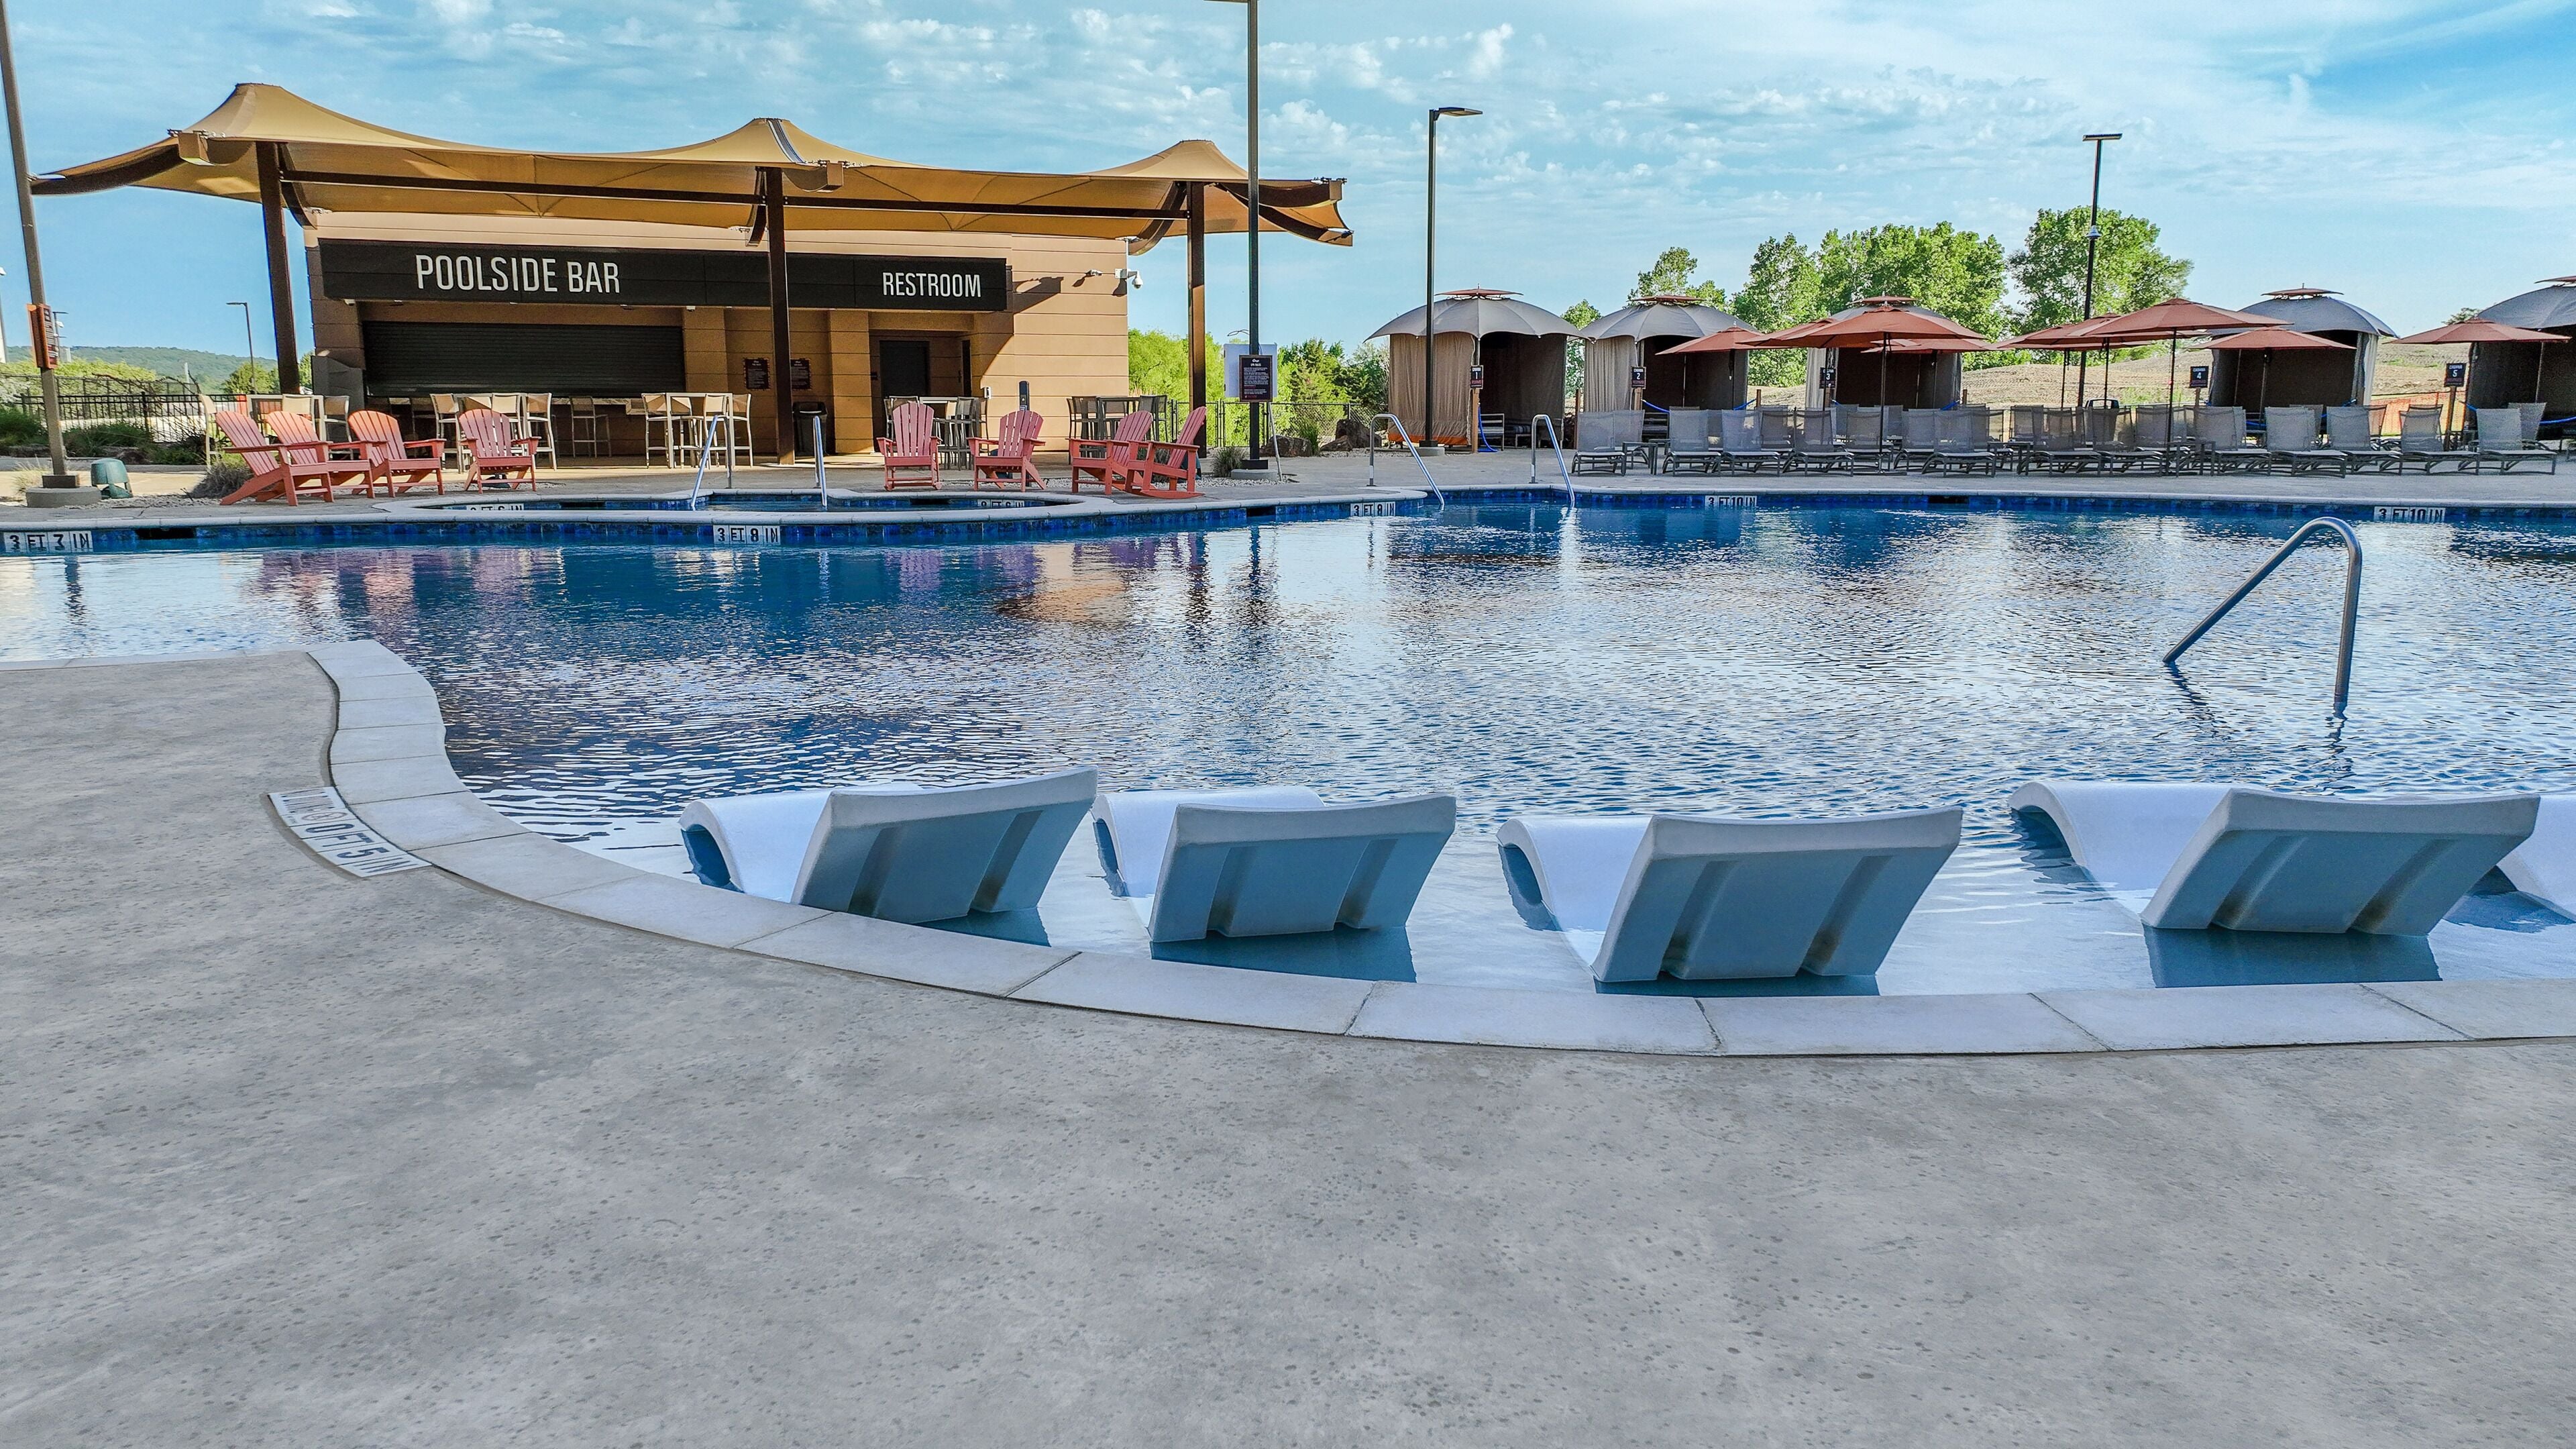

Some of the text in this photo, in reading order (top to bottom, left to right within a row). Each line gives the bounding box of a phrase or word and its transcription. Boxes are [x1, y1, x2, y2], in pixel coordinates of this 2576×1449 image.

[415, 254, 620, 293] POOLSIDE BAR
[882, 272, 981, 298] RESTROOM
[1476, 372, 1478, 380] 1
[2452, 369, 2458, 377] 5
[1708, 496, 1715, 507] 3
[1354, 504, 1360, 516] 3
[2379, 508, 2387, 521] 3
[717, 527, 725, 542] 3
[9, 535, 21, 550] 3
[315, 833, 375, 847] FT
[337, 847, 390, 859] 5
[354, 857, 419, 873] IN
